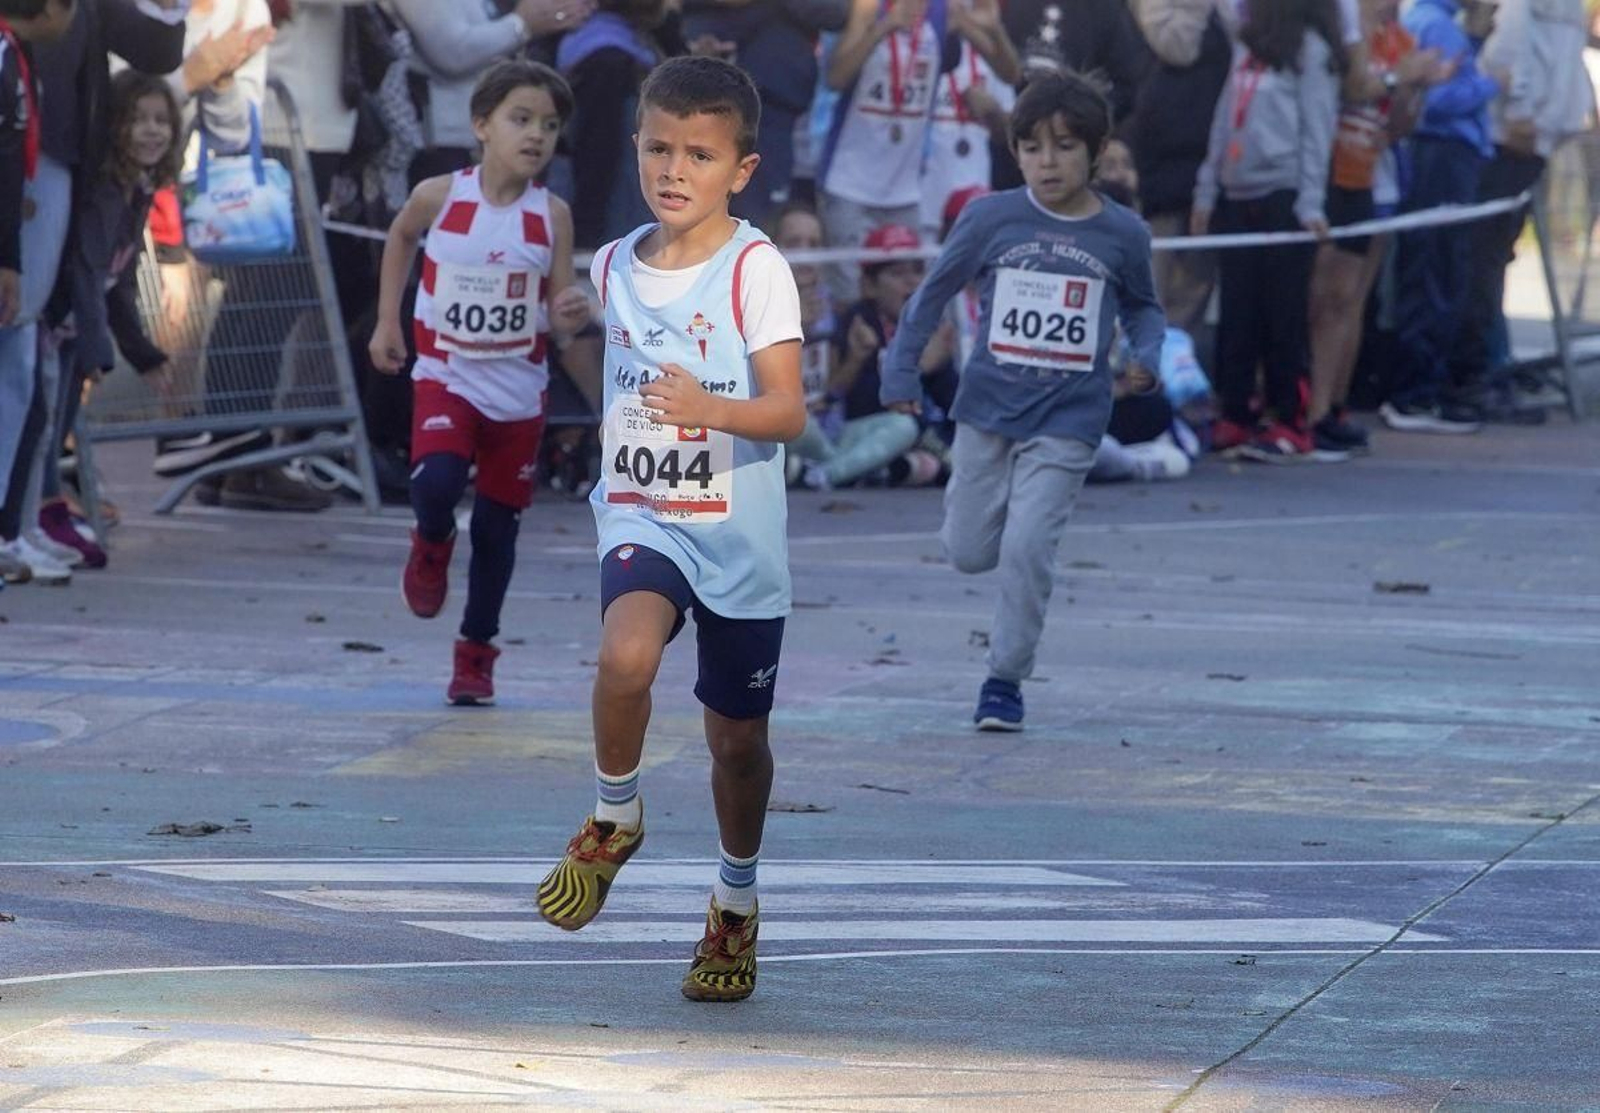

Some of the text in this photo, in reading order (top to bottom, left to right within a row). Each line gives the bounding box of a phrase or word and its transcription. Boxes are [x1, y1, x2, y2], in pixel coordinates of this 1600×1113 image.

[445, 302, 527, 333] 4038
[1002, 307, 1086, 345] 4026
[627, 419, 664, 432] DE VIGO
[614, 444, 713, 489] 4044
